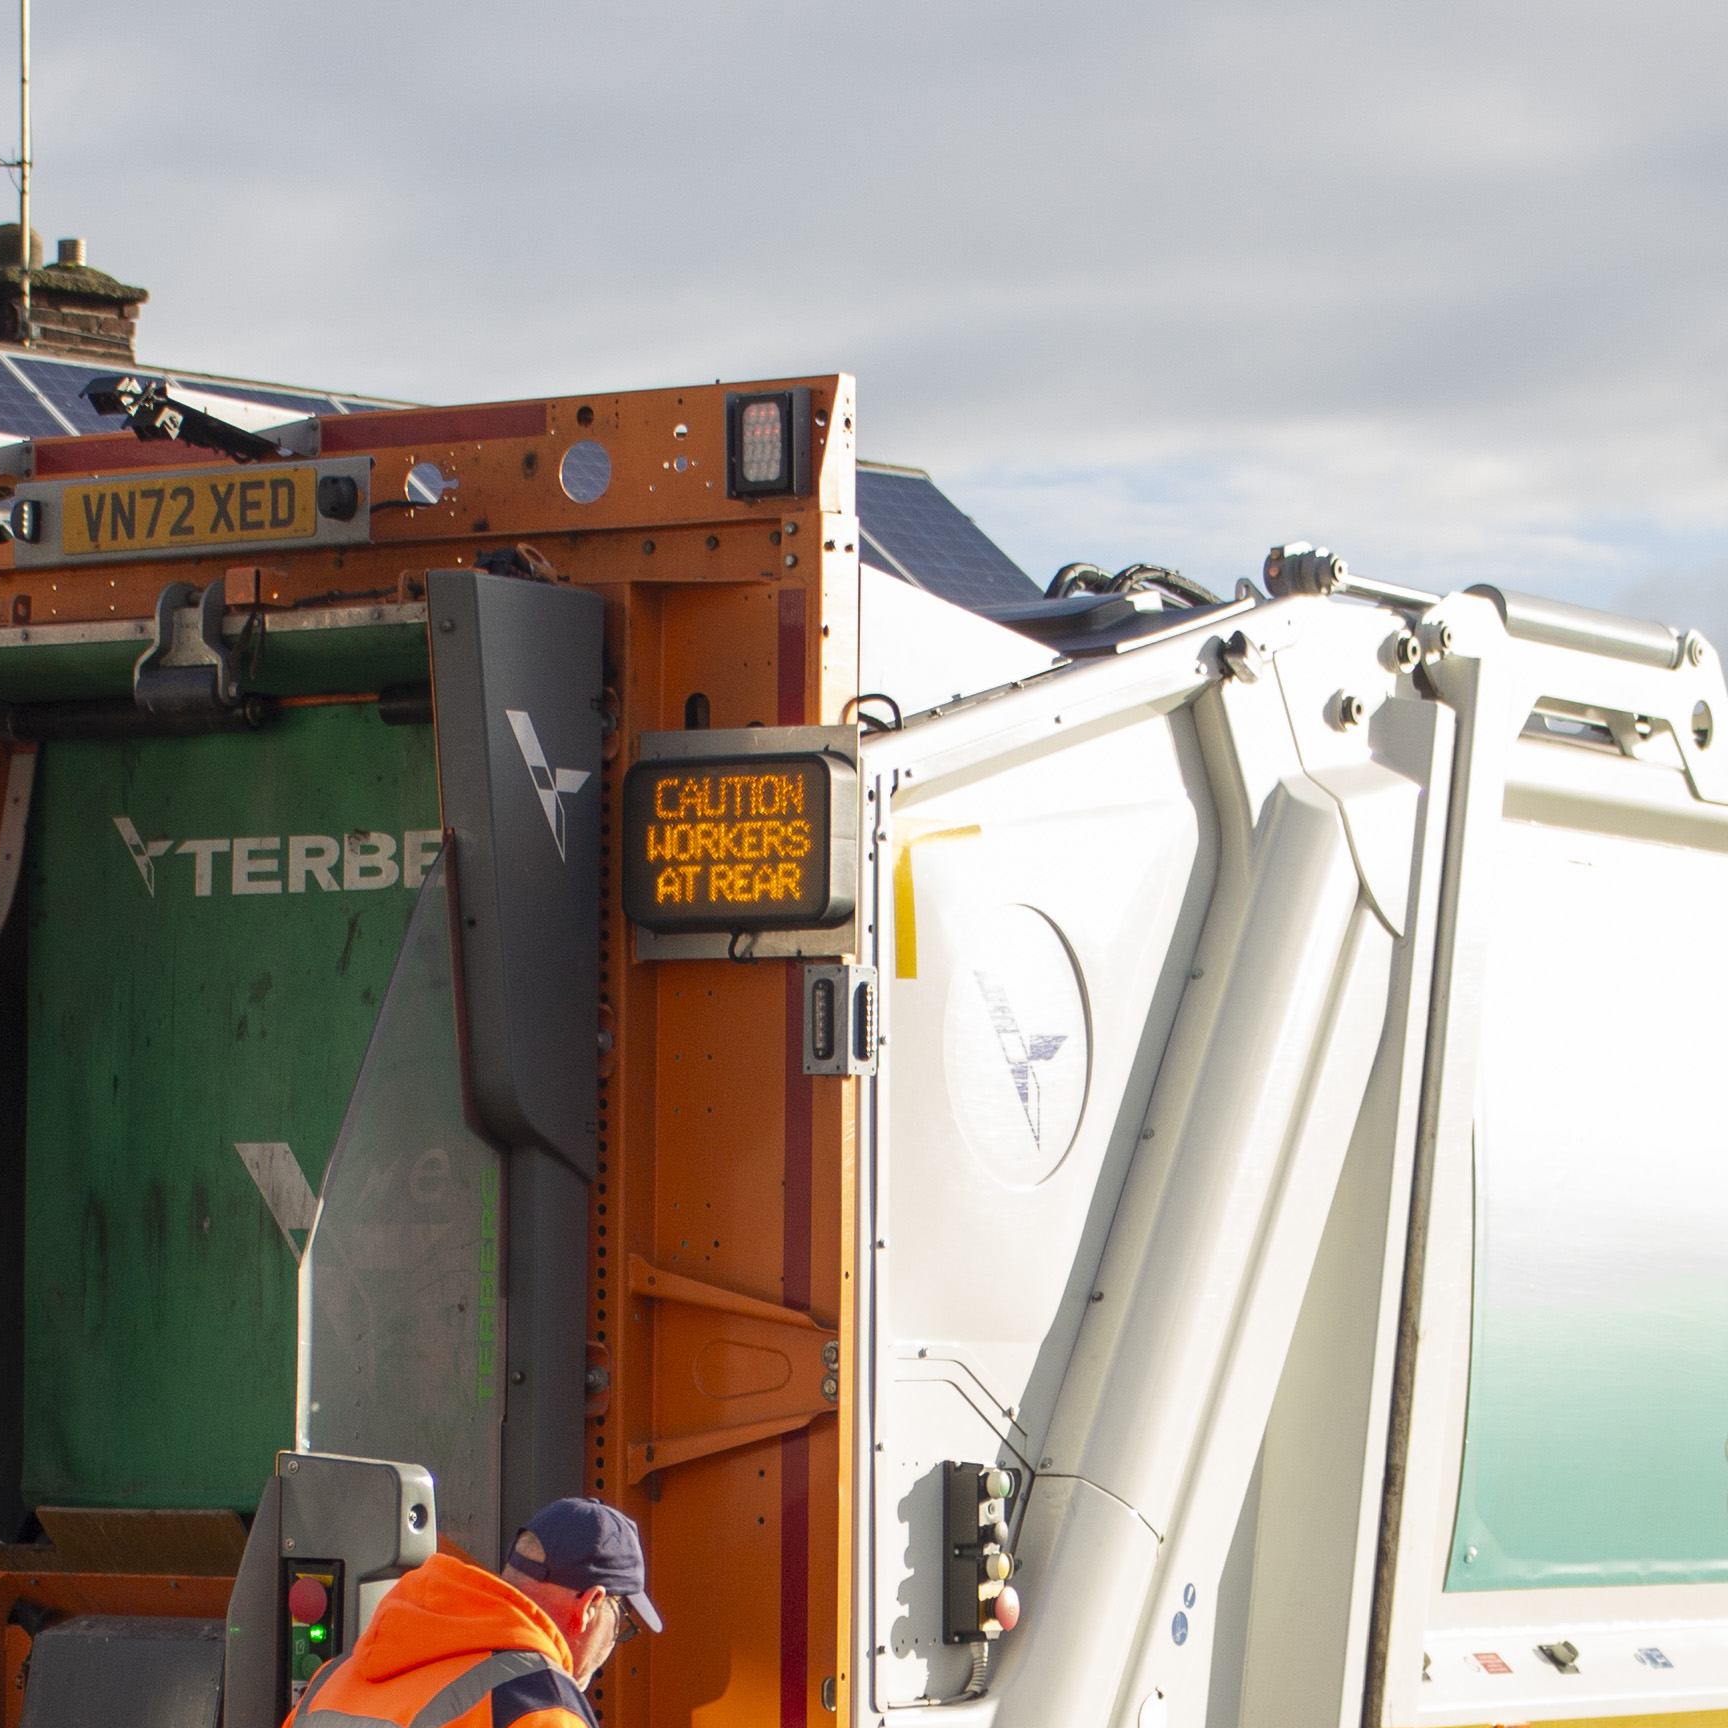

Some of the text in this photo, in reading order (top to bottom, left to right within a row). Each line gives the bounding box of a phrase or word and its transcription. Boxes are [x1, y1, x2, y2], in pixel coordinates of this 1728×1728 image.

[82, 478, 296, 543] VN72 XED
[655, 774, 804, 820] CAUTION
[646, 819, 812, 864] WORKERS
[656, 862, 803, 904] AT REAR
[478, 1166, 498, 1408] TERBERG
